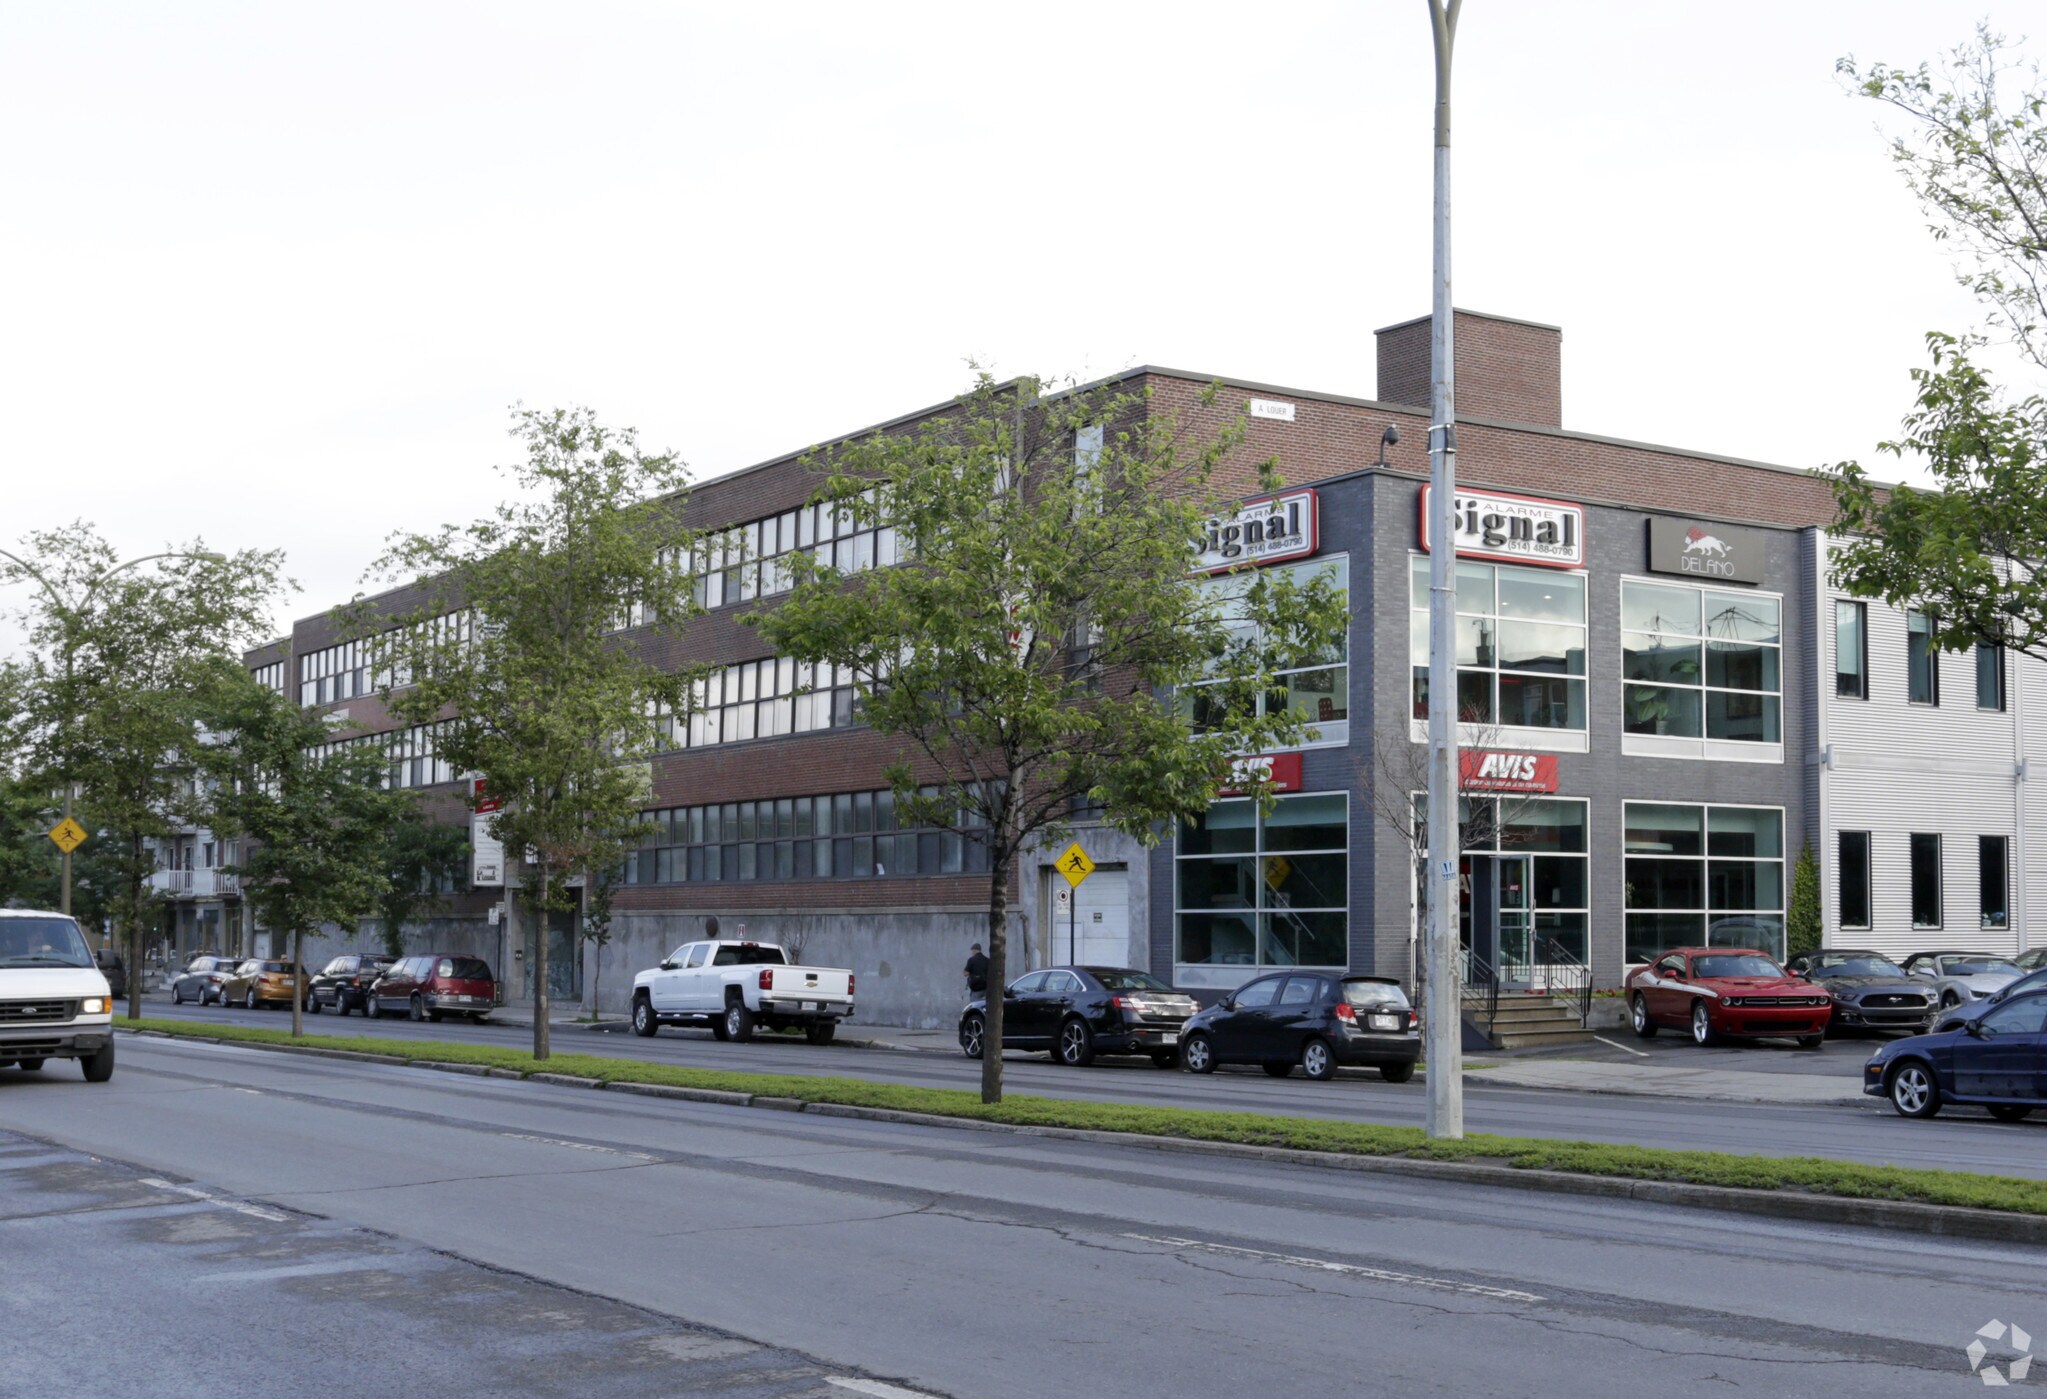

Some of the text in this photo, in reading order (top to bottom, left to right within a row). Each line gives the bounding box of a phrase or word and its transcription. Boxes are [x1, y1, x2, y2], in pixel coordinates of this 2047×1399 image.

[1482, 503, 1554, 519] ALARME
[1246, 543, 1266, 557] (514)
[1507, 540, 1574, 557] (514) 488-0790
[1681, 555, 1735, 577] DELANO
[1477, 753, 1537, 781] AVIS
